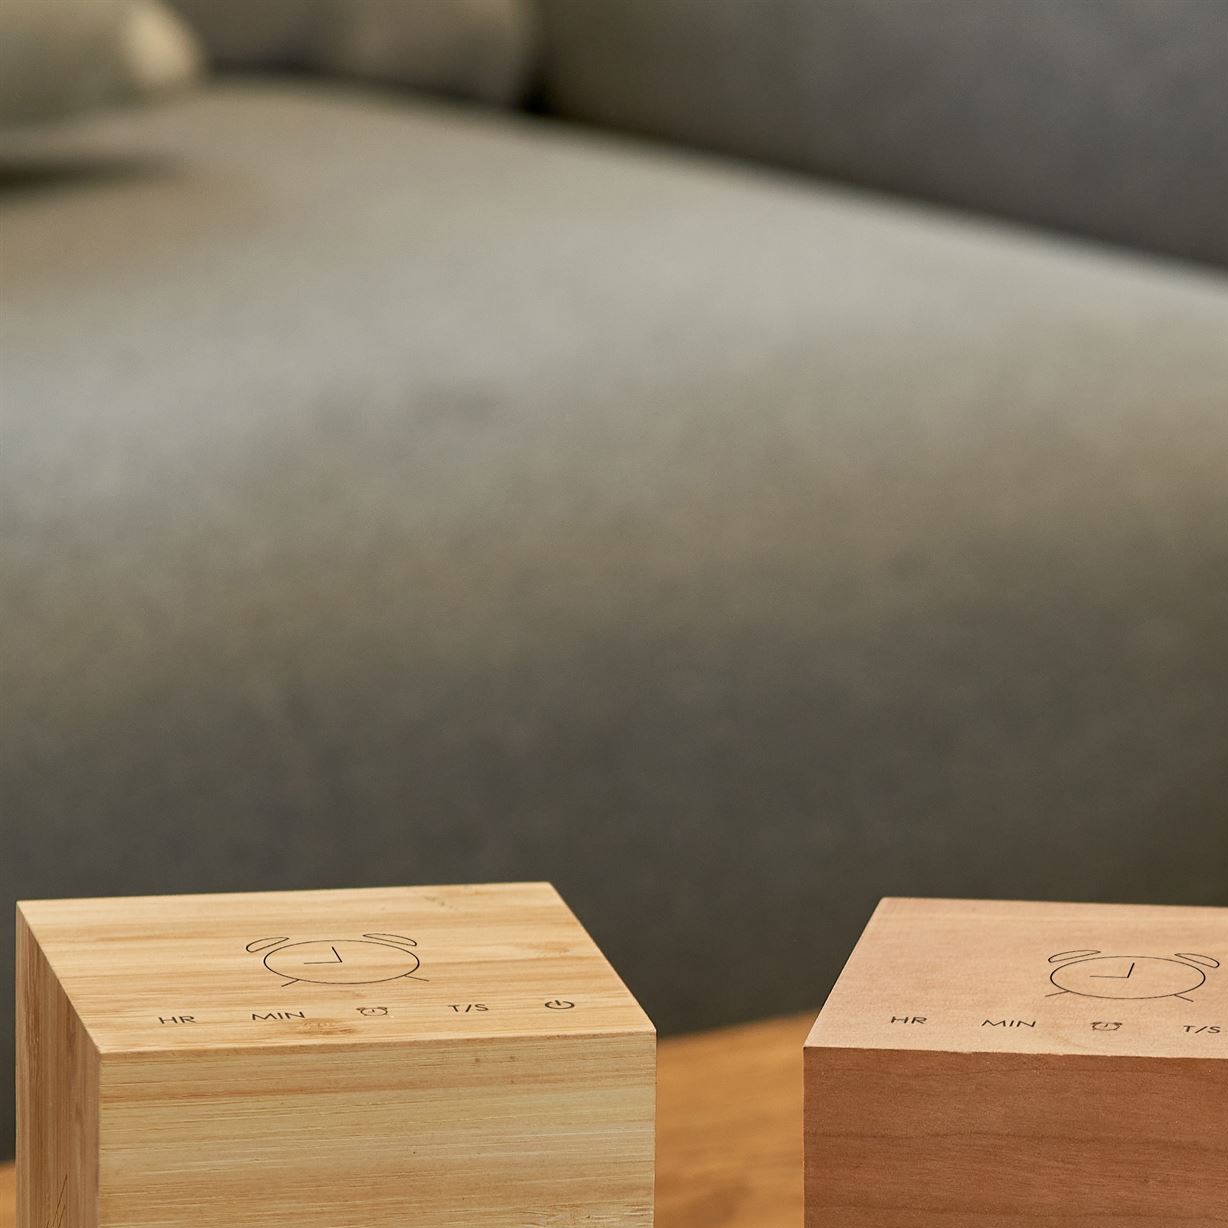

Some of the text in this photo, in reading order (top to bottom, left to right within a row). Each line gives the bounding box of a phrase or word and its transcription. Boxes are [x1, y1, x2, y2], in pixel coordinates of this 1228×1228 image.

[158, 1003, 489, 1025] HR MIN T/S
[891, 1015, 1222, 1035] HR MIN T/S
